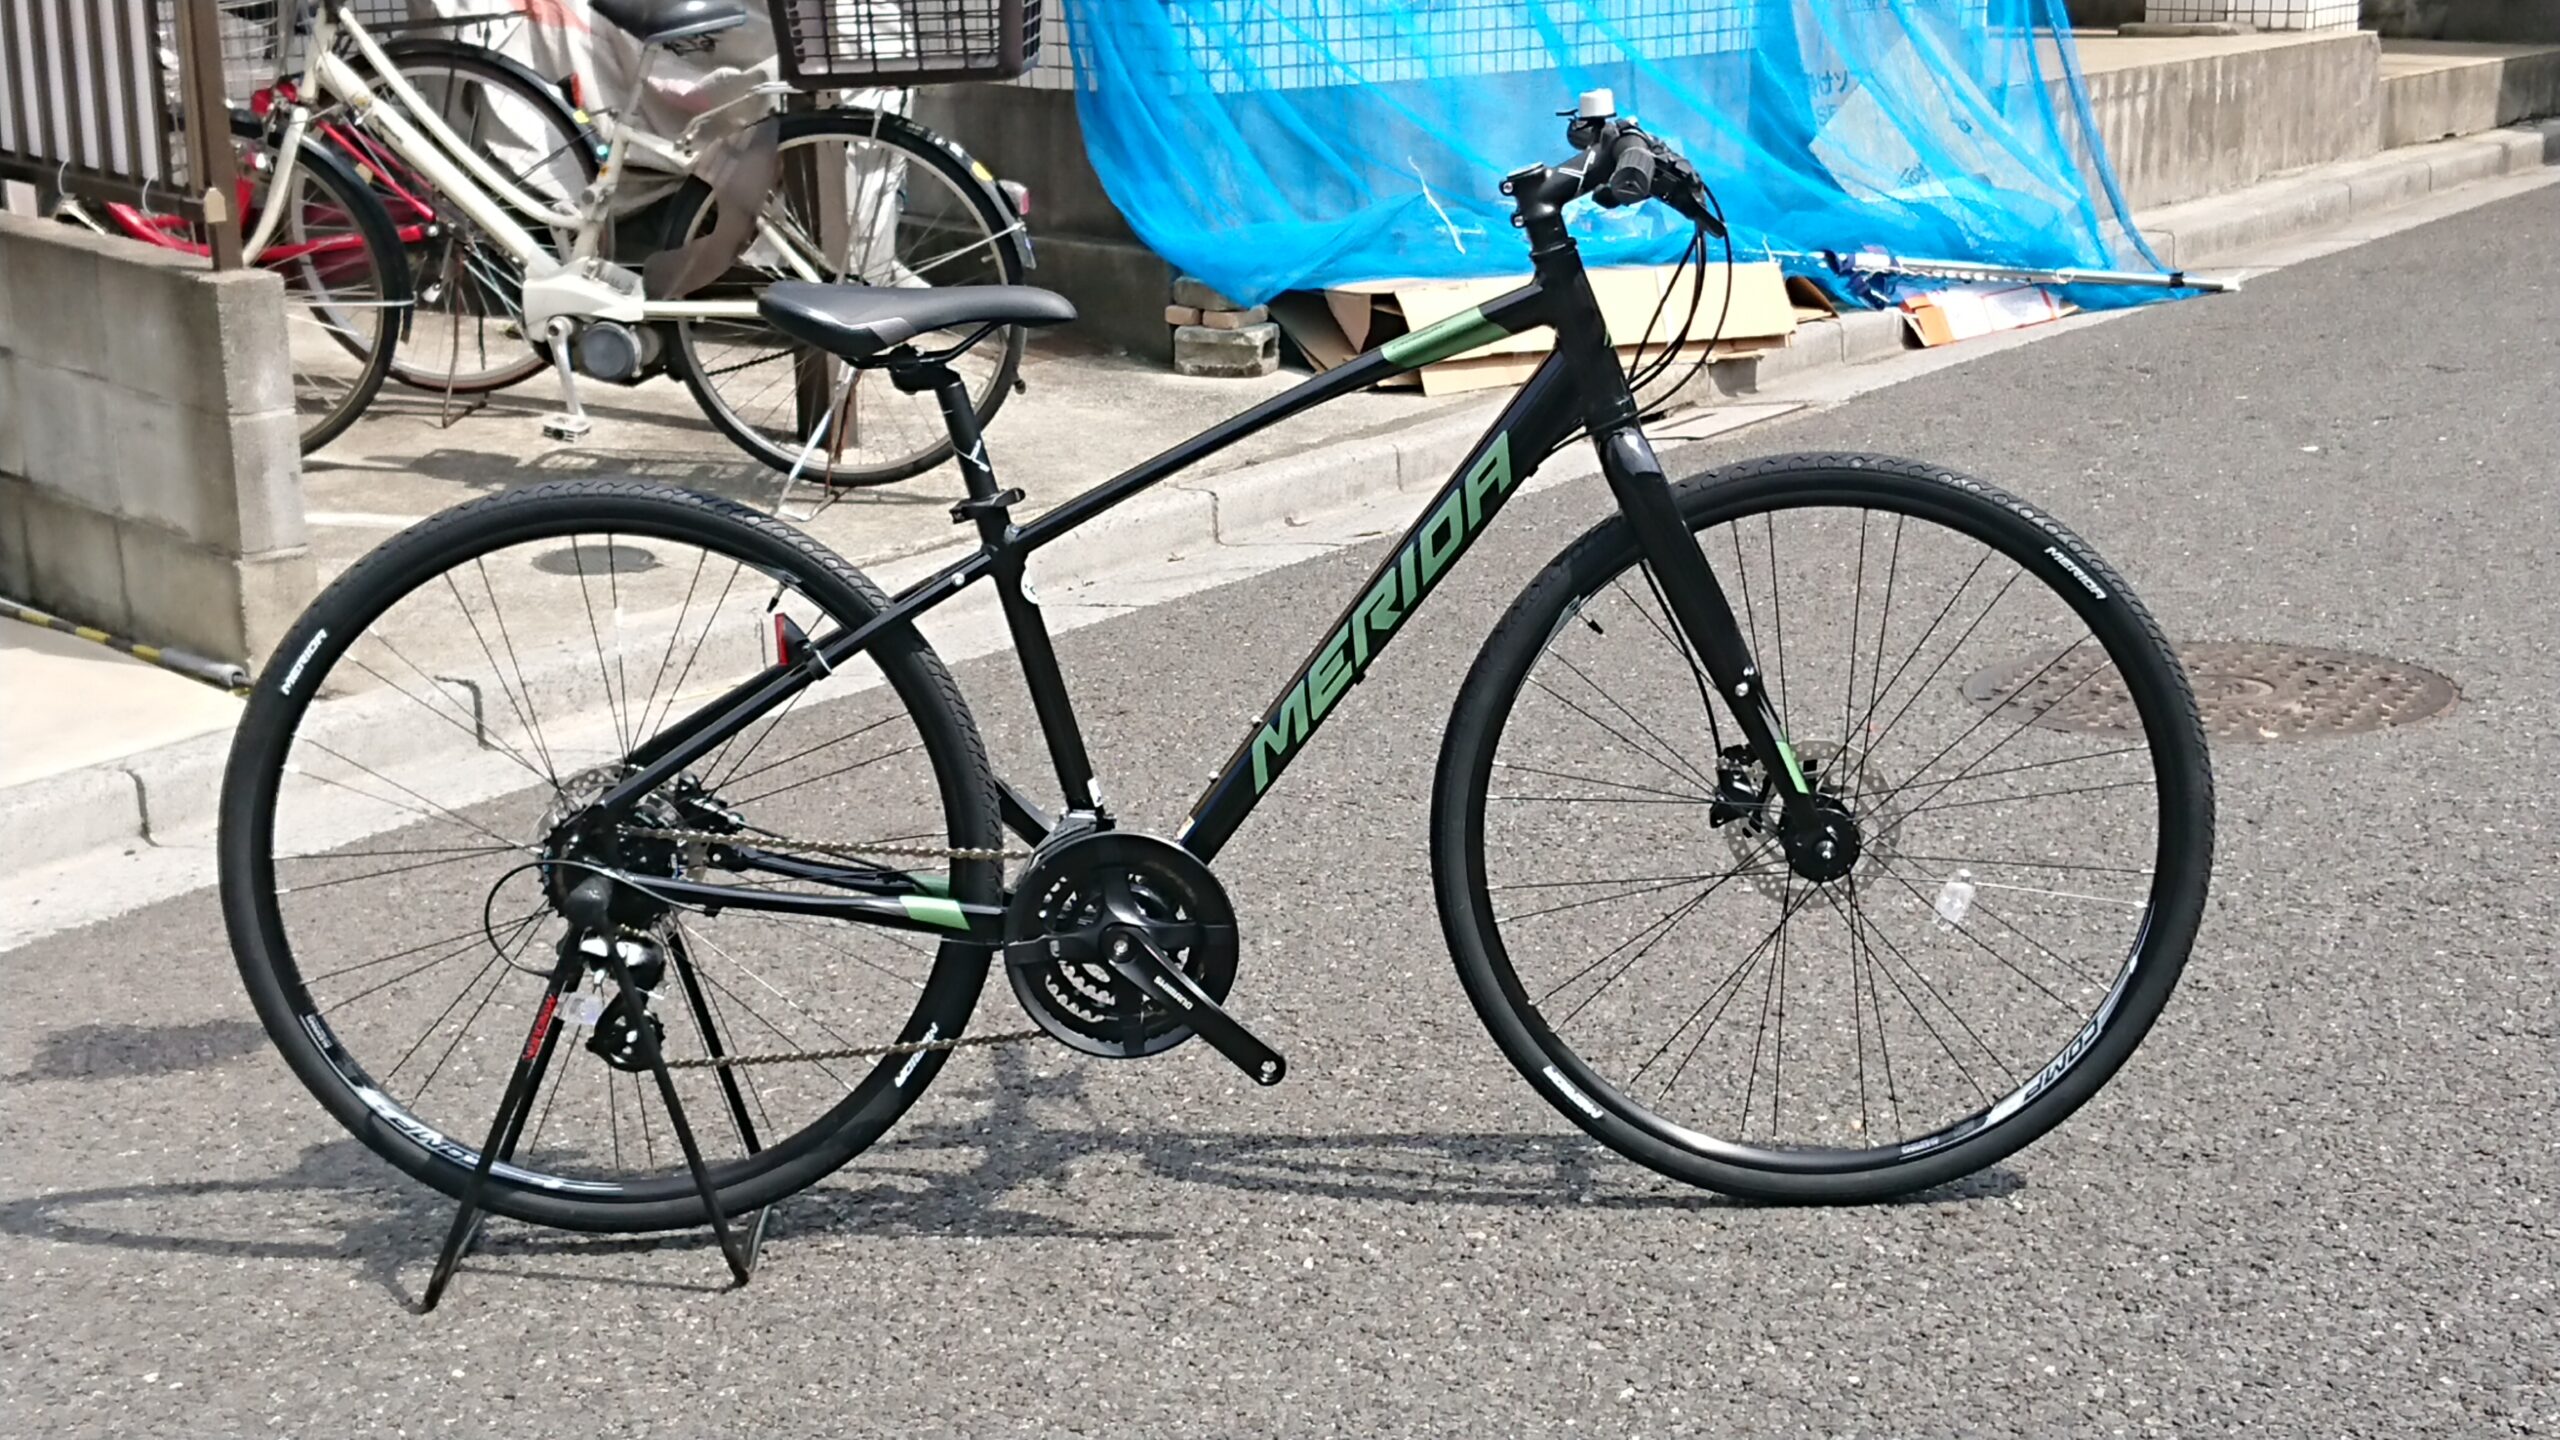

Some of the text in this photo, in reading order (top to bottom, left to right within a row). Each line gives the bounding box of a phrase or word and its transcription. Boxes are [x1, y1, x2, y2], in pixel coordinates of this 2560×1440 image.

[2044, 546, 2107, 599] MERIDA
[1251, 430, 1512, 795] MERIDA
[281, 628, 328, 696] MERIDA
[2023, 1016, 2101, 1102] COMP
